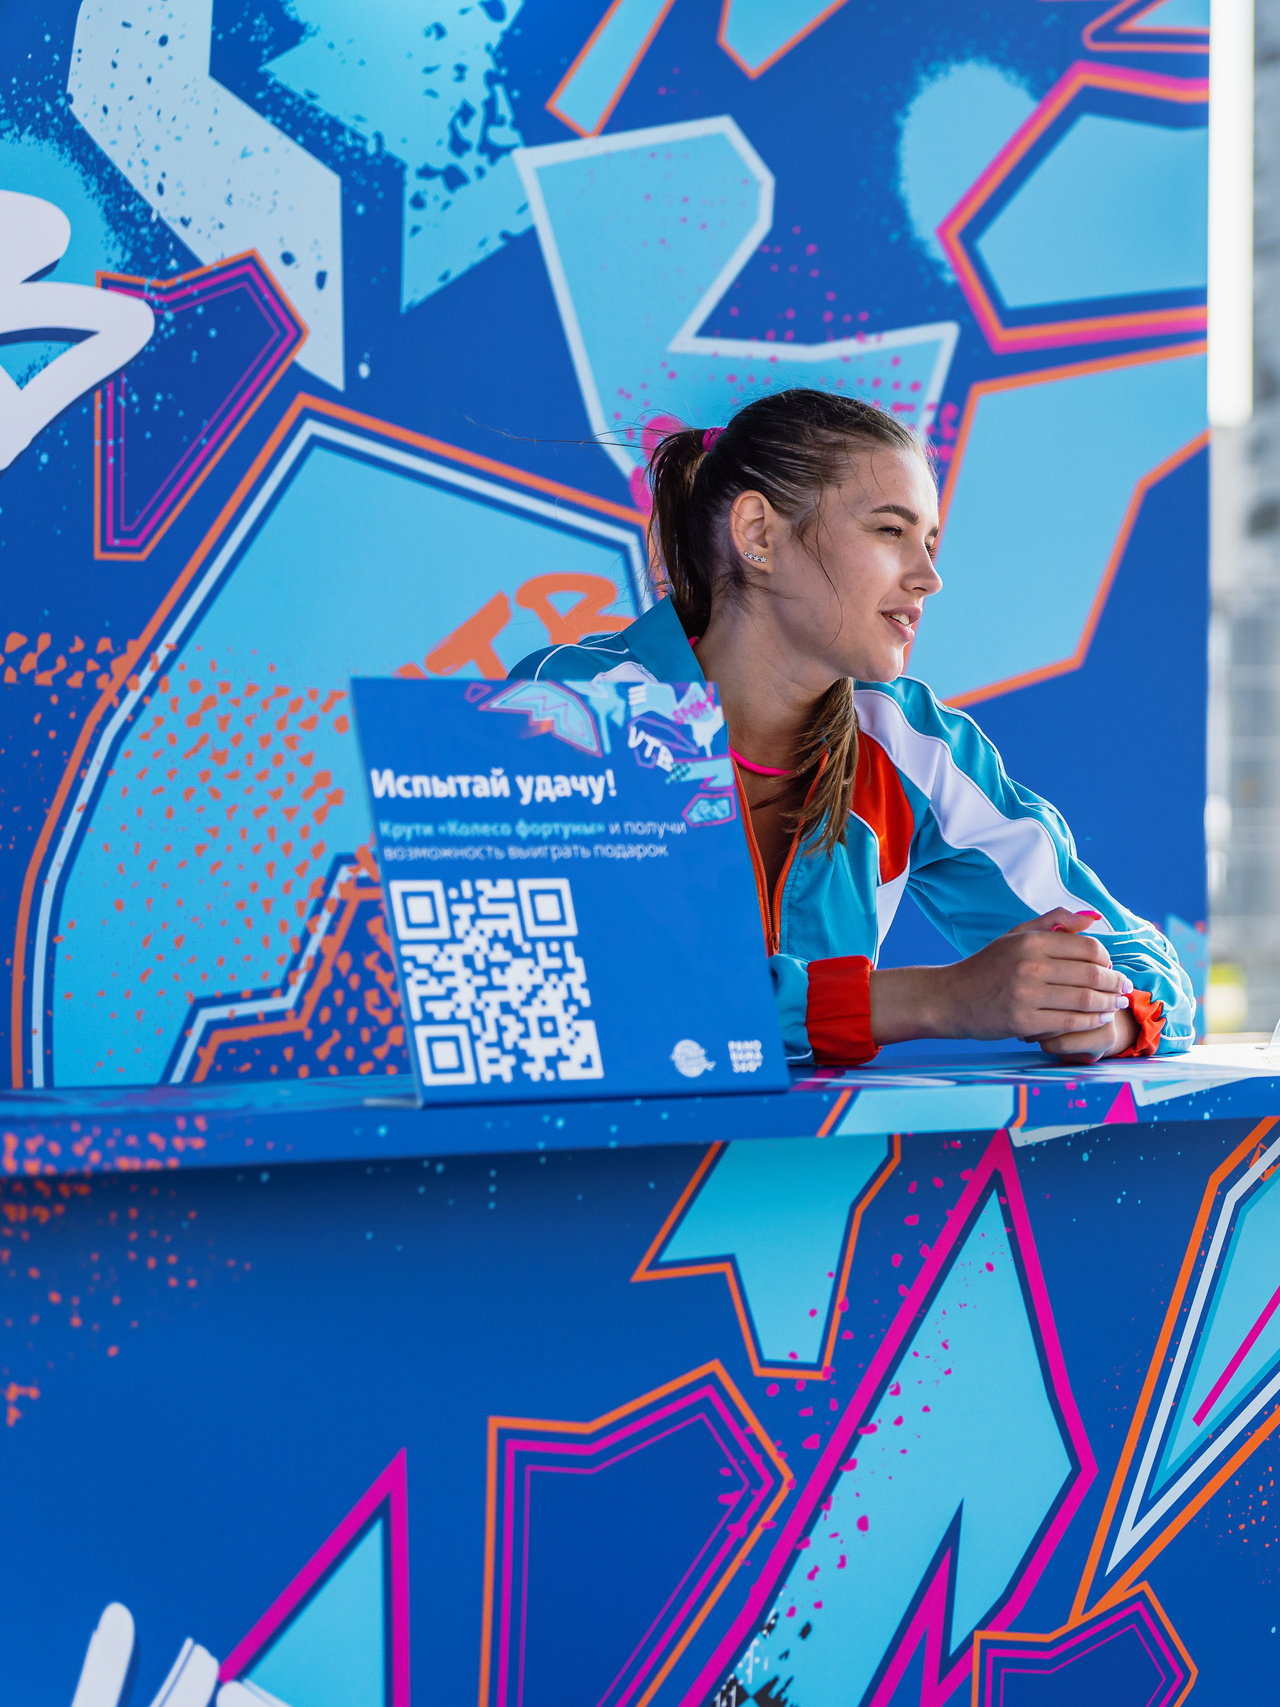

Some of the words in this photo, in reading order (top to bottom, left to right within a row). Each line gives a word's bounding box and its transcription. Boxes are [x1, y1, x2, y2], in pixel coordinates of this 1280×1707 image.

[627, 725, 674, 772] VTB
[370, 767, 511, 799] Испытай
[514, 768, 618, 806] удачу!
[379, 819, 435, 842] Крути
[437, 819, 513, 837] «Колесо
[608, 821, 622, 836] и
[623, 820, 688, 840] получи
[383, 845, 506, 862] возможность
[507, 844, 592, 863] выиграть
[594, 843, 669, 862] подарок
